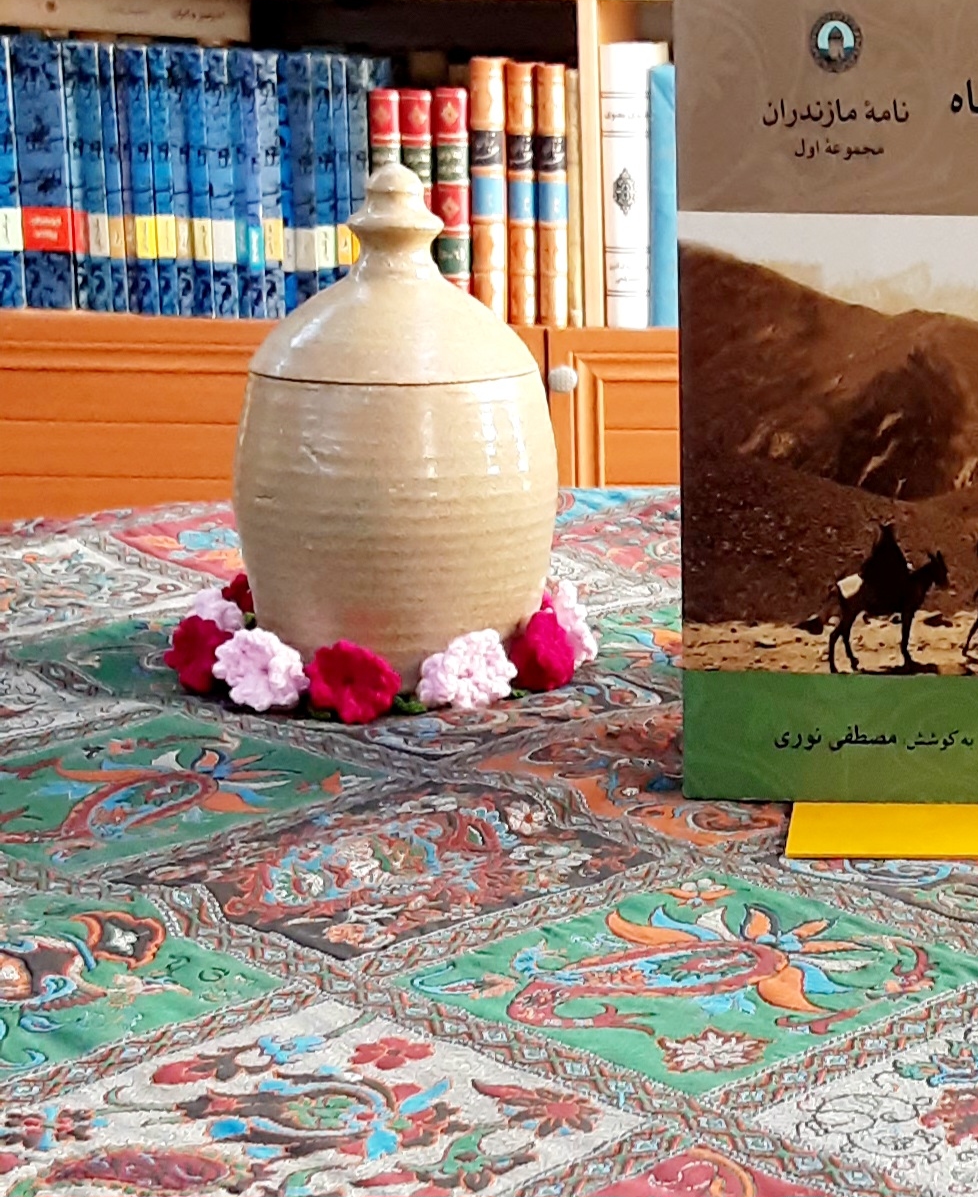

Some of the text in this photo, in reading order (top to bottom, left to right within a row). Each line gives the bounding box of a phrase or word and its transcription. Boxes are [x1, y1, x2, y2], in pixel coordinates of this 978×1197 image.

[762, 98, 858, 128] مازندران
[794, 138, 820, 159] اول
[773, 727, 823, 750] نوری
[828, 725, 897, 751] مصطفی
